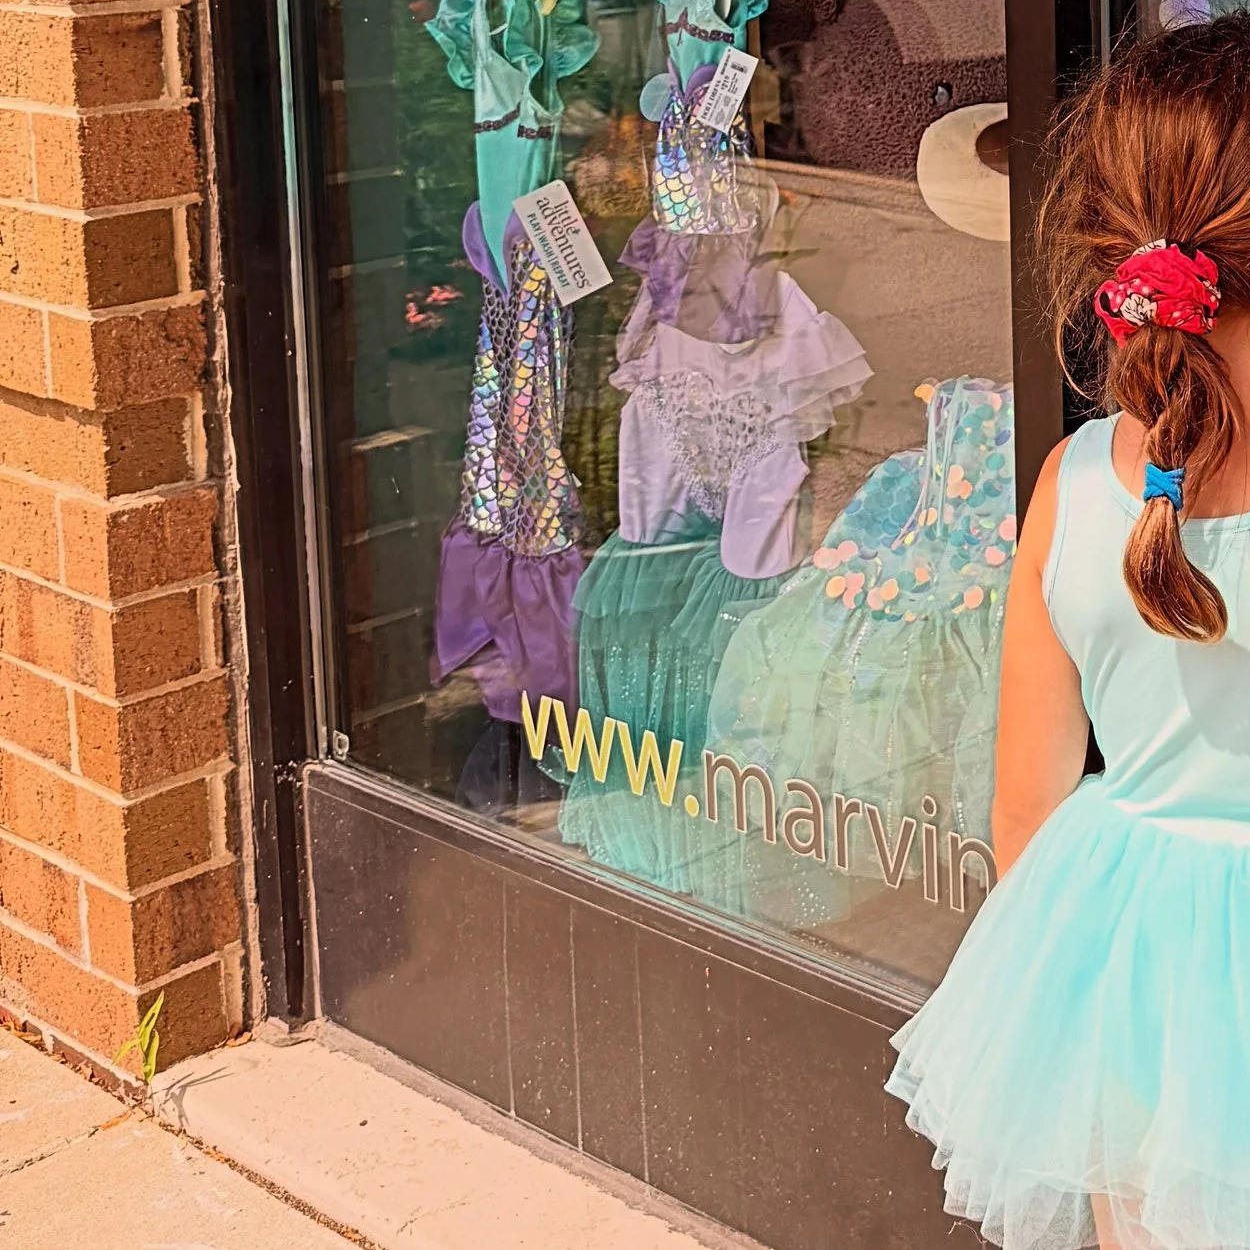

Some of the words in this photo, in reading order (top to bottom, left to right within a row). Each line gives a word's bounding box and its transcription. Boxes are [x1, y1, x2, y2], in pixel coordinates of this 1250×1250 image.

[536, 197, 589, 289] adventures
[554, 200, 578, 236] little
[538, 235, 555, 261] WASH
[551, 260, 571, 287] REPEAT
